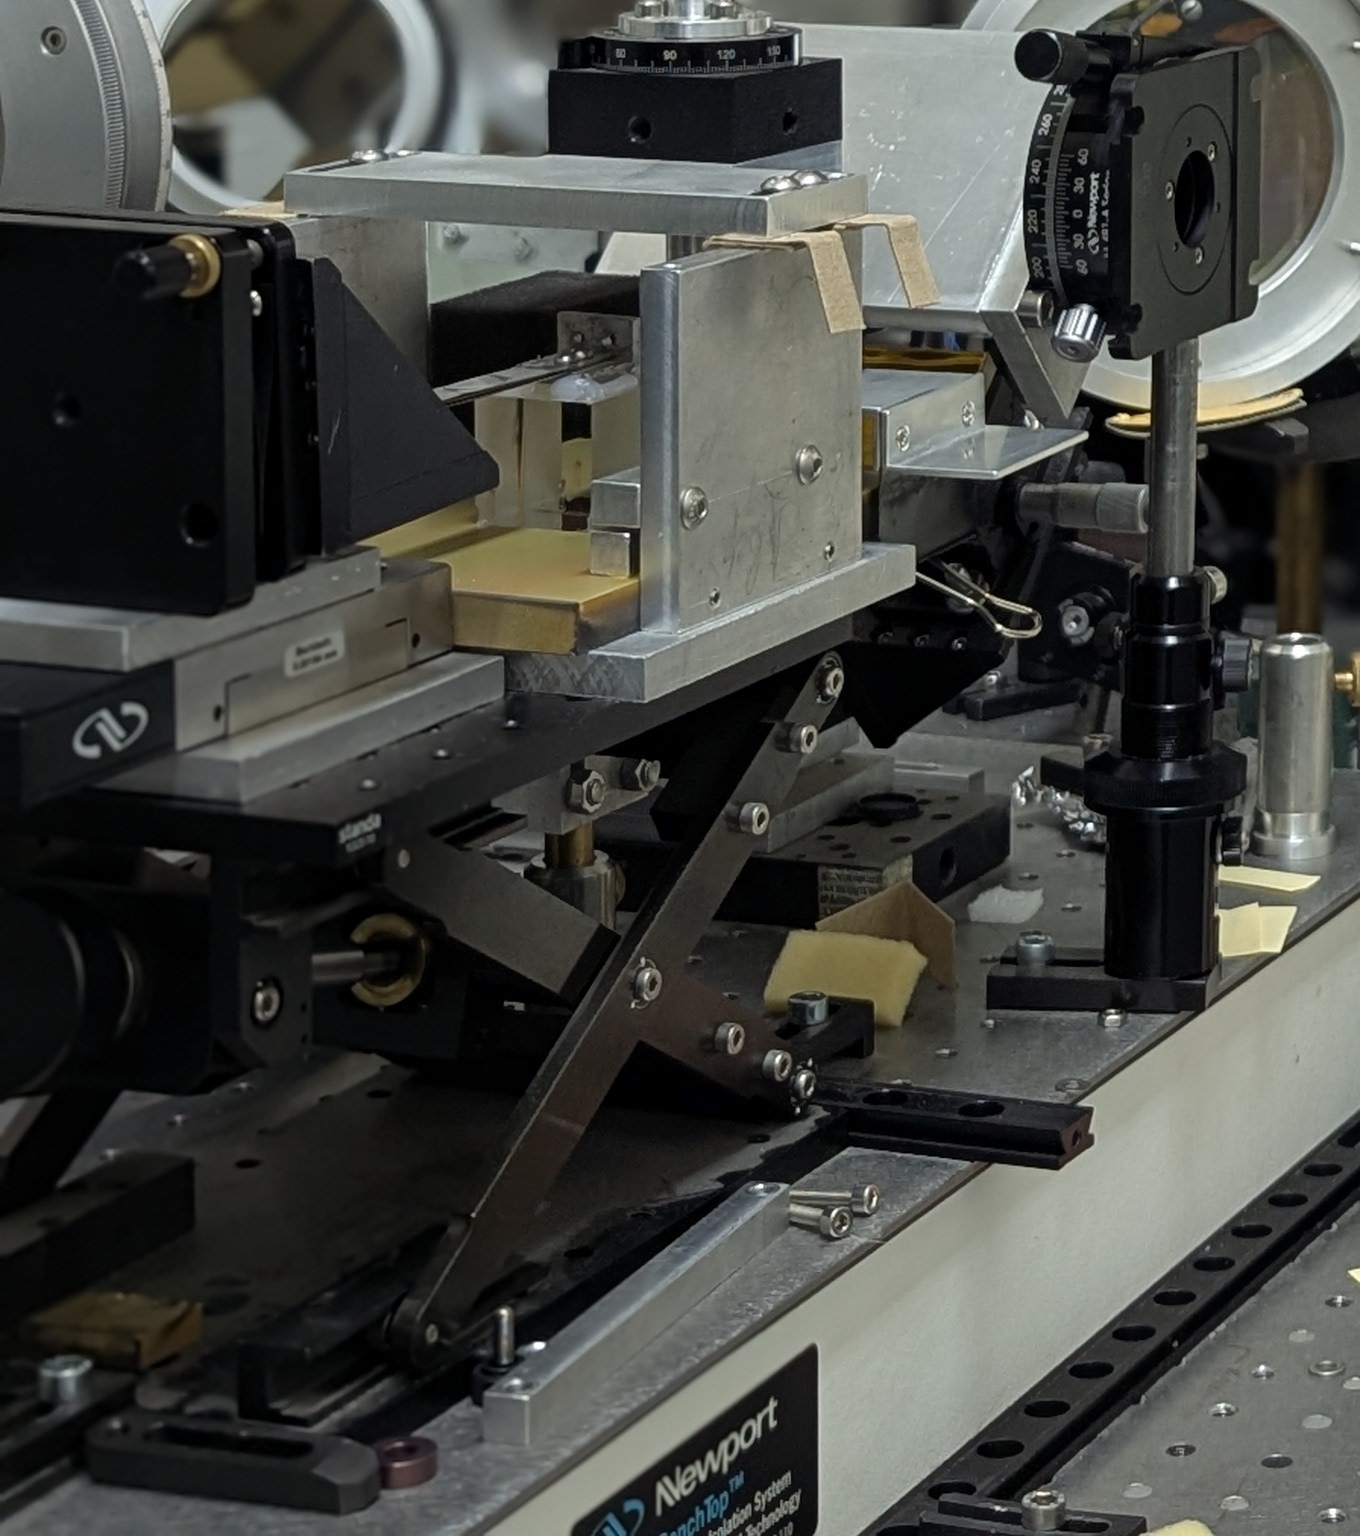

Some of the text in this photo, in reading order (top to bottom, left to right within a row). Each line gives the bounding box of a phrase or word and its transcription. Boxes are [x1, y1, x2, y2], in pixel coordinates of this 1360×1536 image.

[663, 50, 677, 61] 90
[717, 49, 736, 60] 120
[1038, 113, 1053, 136] 260
[1029, 159, 1042, 184] 240
[1072, 148, 1089, 275] 60 30 0 30 60
[1087, 171, 1101, 228] Newport
[1027, 209, 1039, 234] 220
[1031, 256, 1045, 279] 200
[655, 1396, 779, 1517] Newport
[753, 1470, 792, 1512] System
